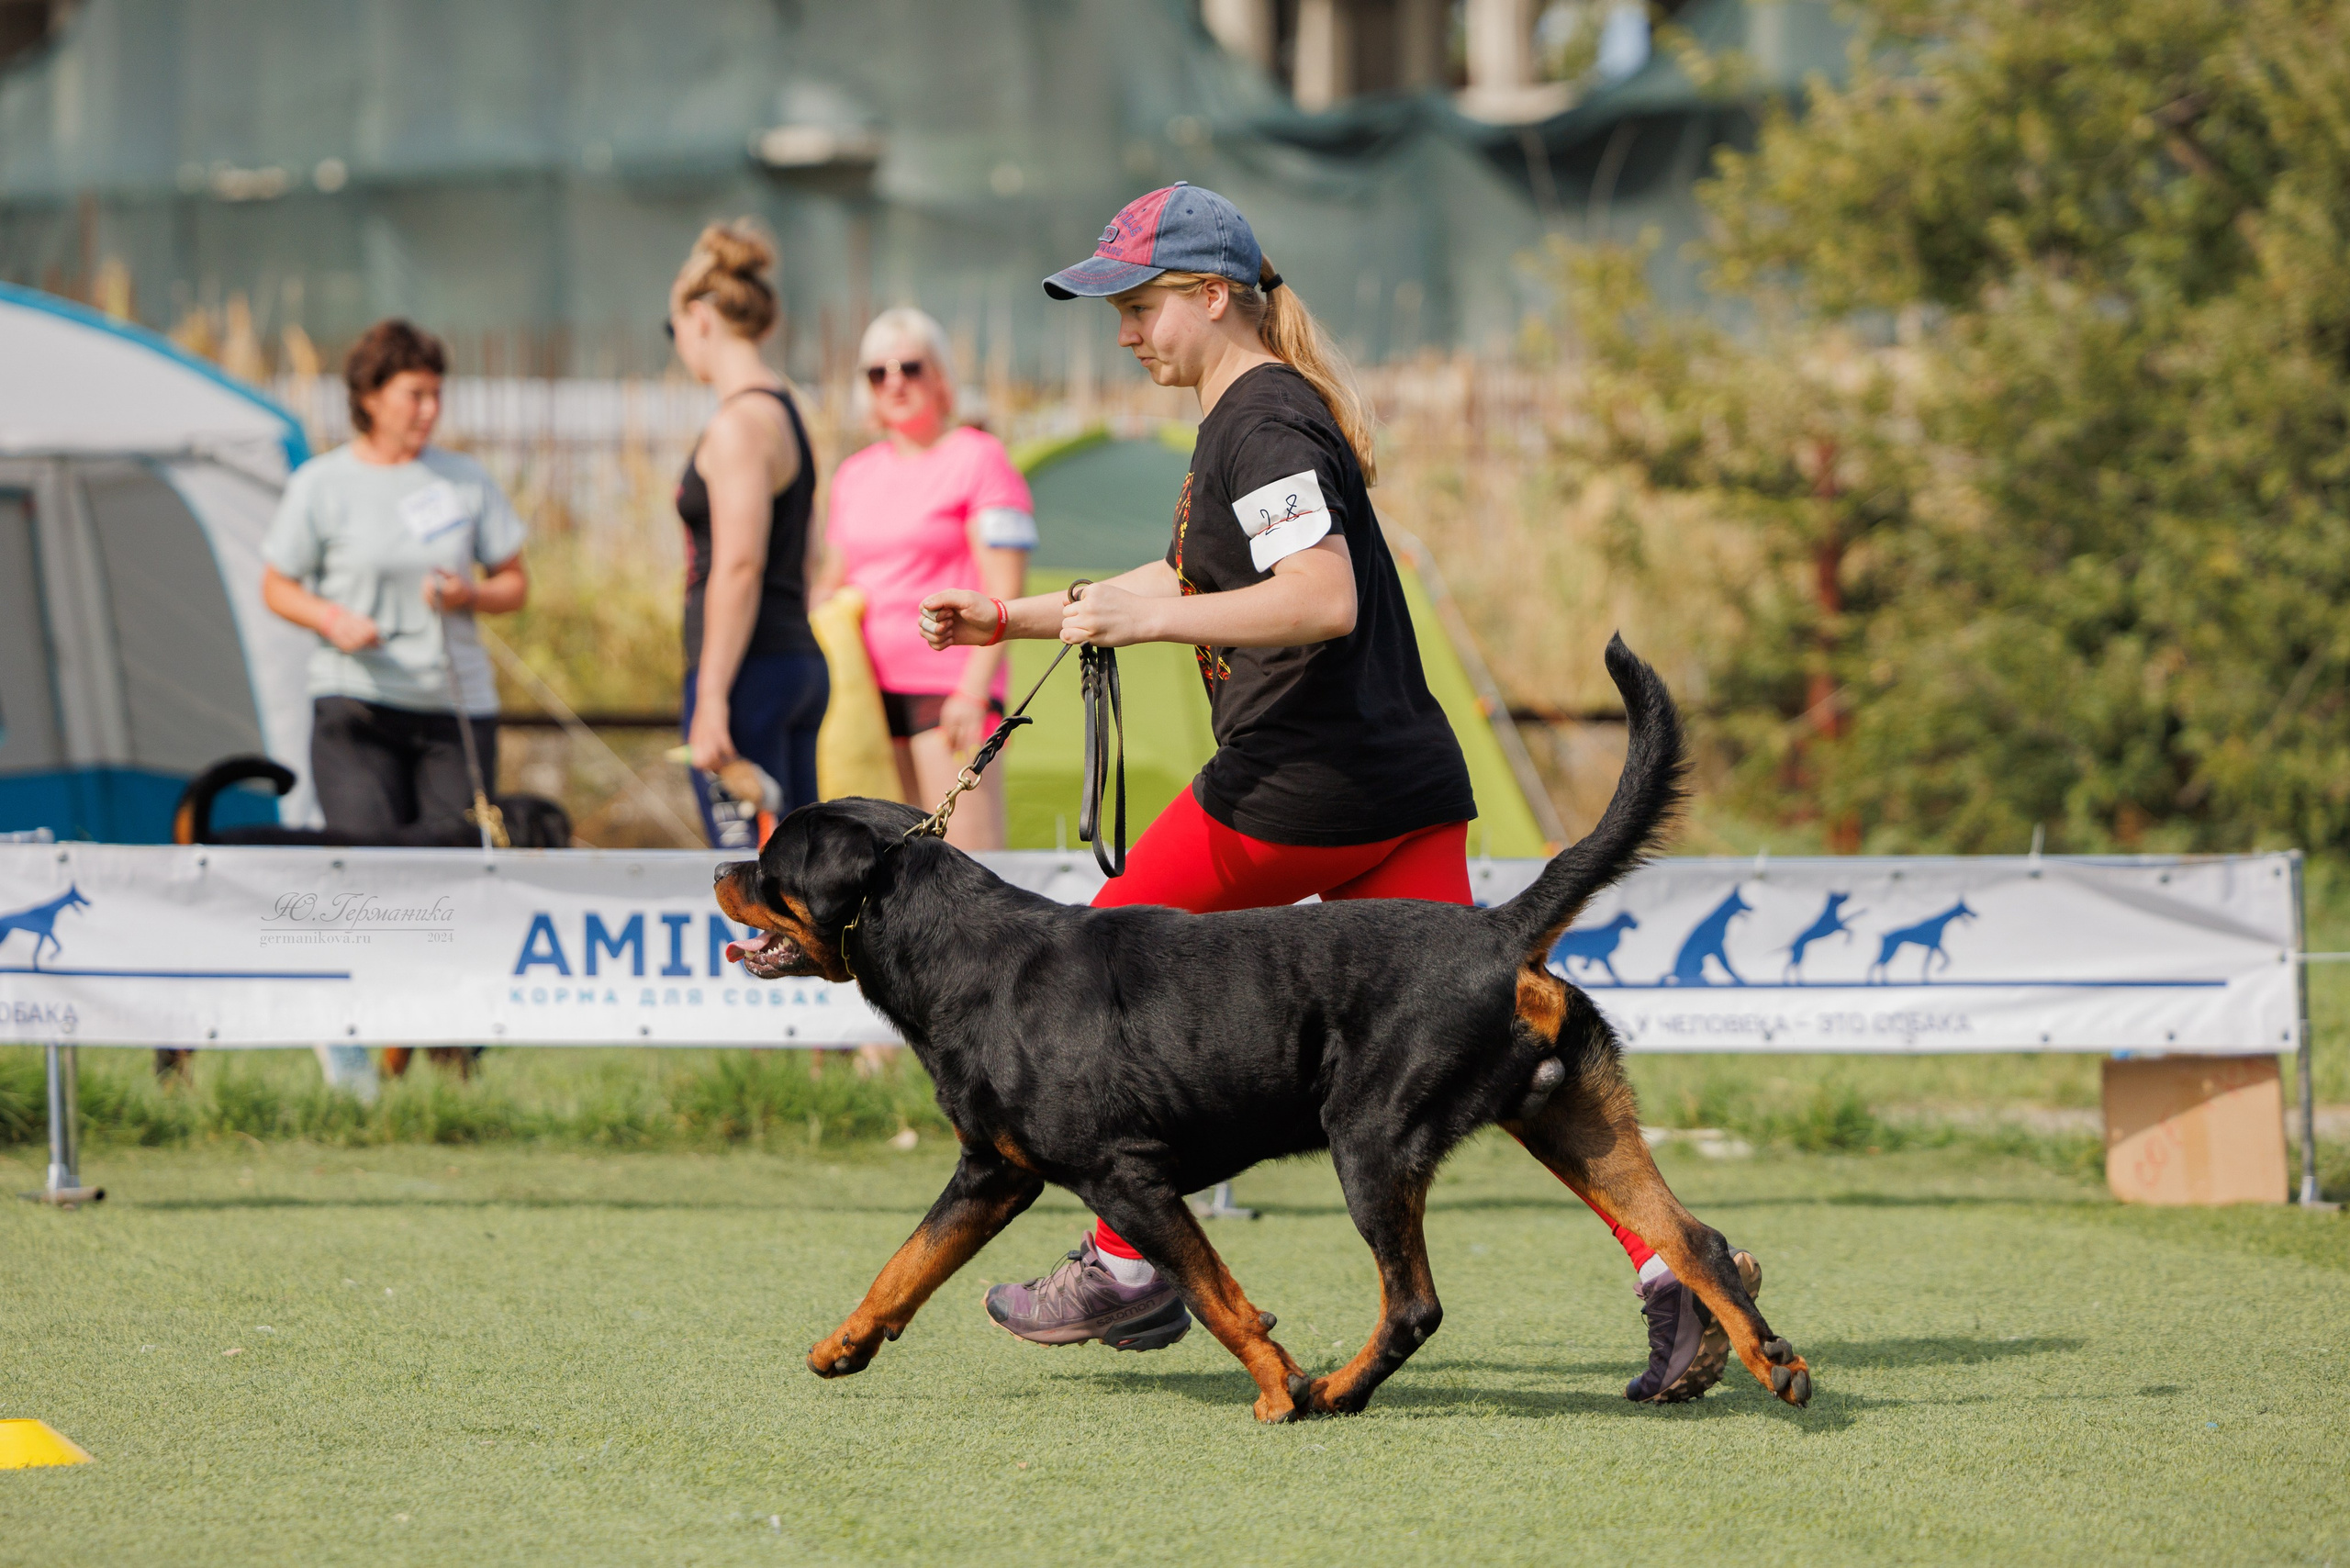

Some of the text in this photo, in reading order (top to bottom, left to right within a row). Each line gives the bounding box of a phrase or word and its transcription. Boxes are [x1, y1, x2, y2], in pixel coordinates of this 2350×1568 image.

[509, 987, 830, 1007] КОРМА ДЛЯ СОБАК
